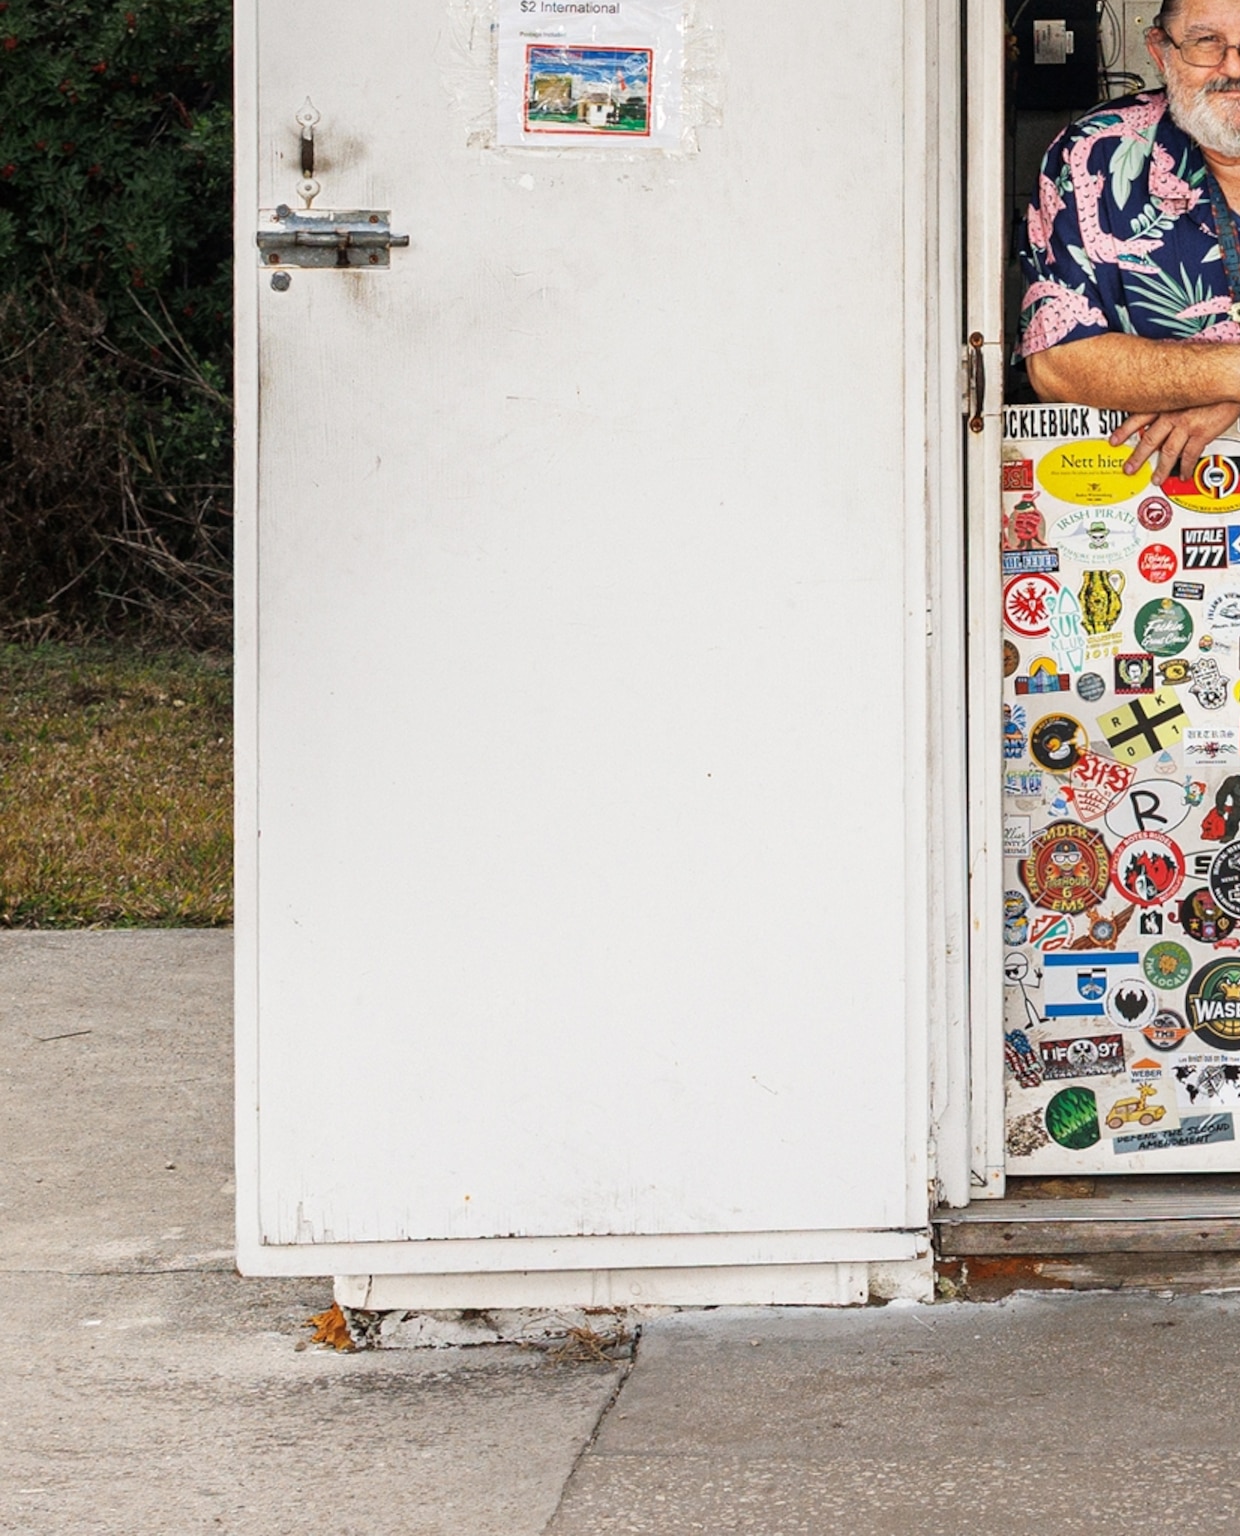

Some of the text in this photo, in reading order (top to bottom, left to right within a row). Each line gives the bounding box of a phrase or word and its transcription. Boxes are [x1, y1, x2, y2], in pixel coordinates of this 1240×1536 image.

[520, 0, 620, 14] $2 International
[1061, 454, 1094, 468] Nett
[1057, 508, 1138, 531] IRISH PIRATE
[1185, 529, 1224, 544] VITALE
[1185, 545, 1225, 568] 777
[1050, 613, 1081, 640] SUP
[1051, 636, 1086, 652] KLUB
[1062, 886, 1073, 898] 6
[1051, 897, 1086, 911] EMS
[1145, 957, 1189, 987] THE LOCALS
[1117, 1123, 1231, 1144] DEFEND THE SECOND
[1138, 1133, 1214, 1151] AMENDMENT
